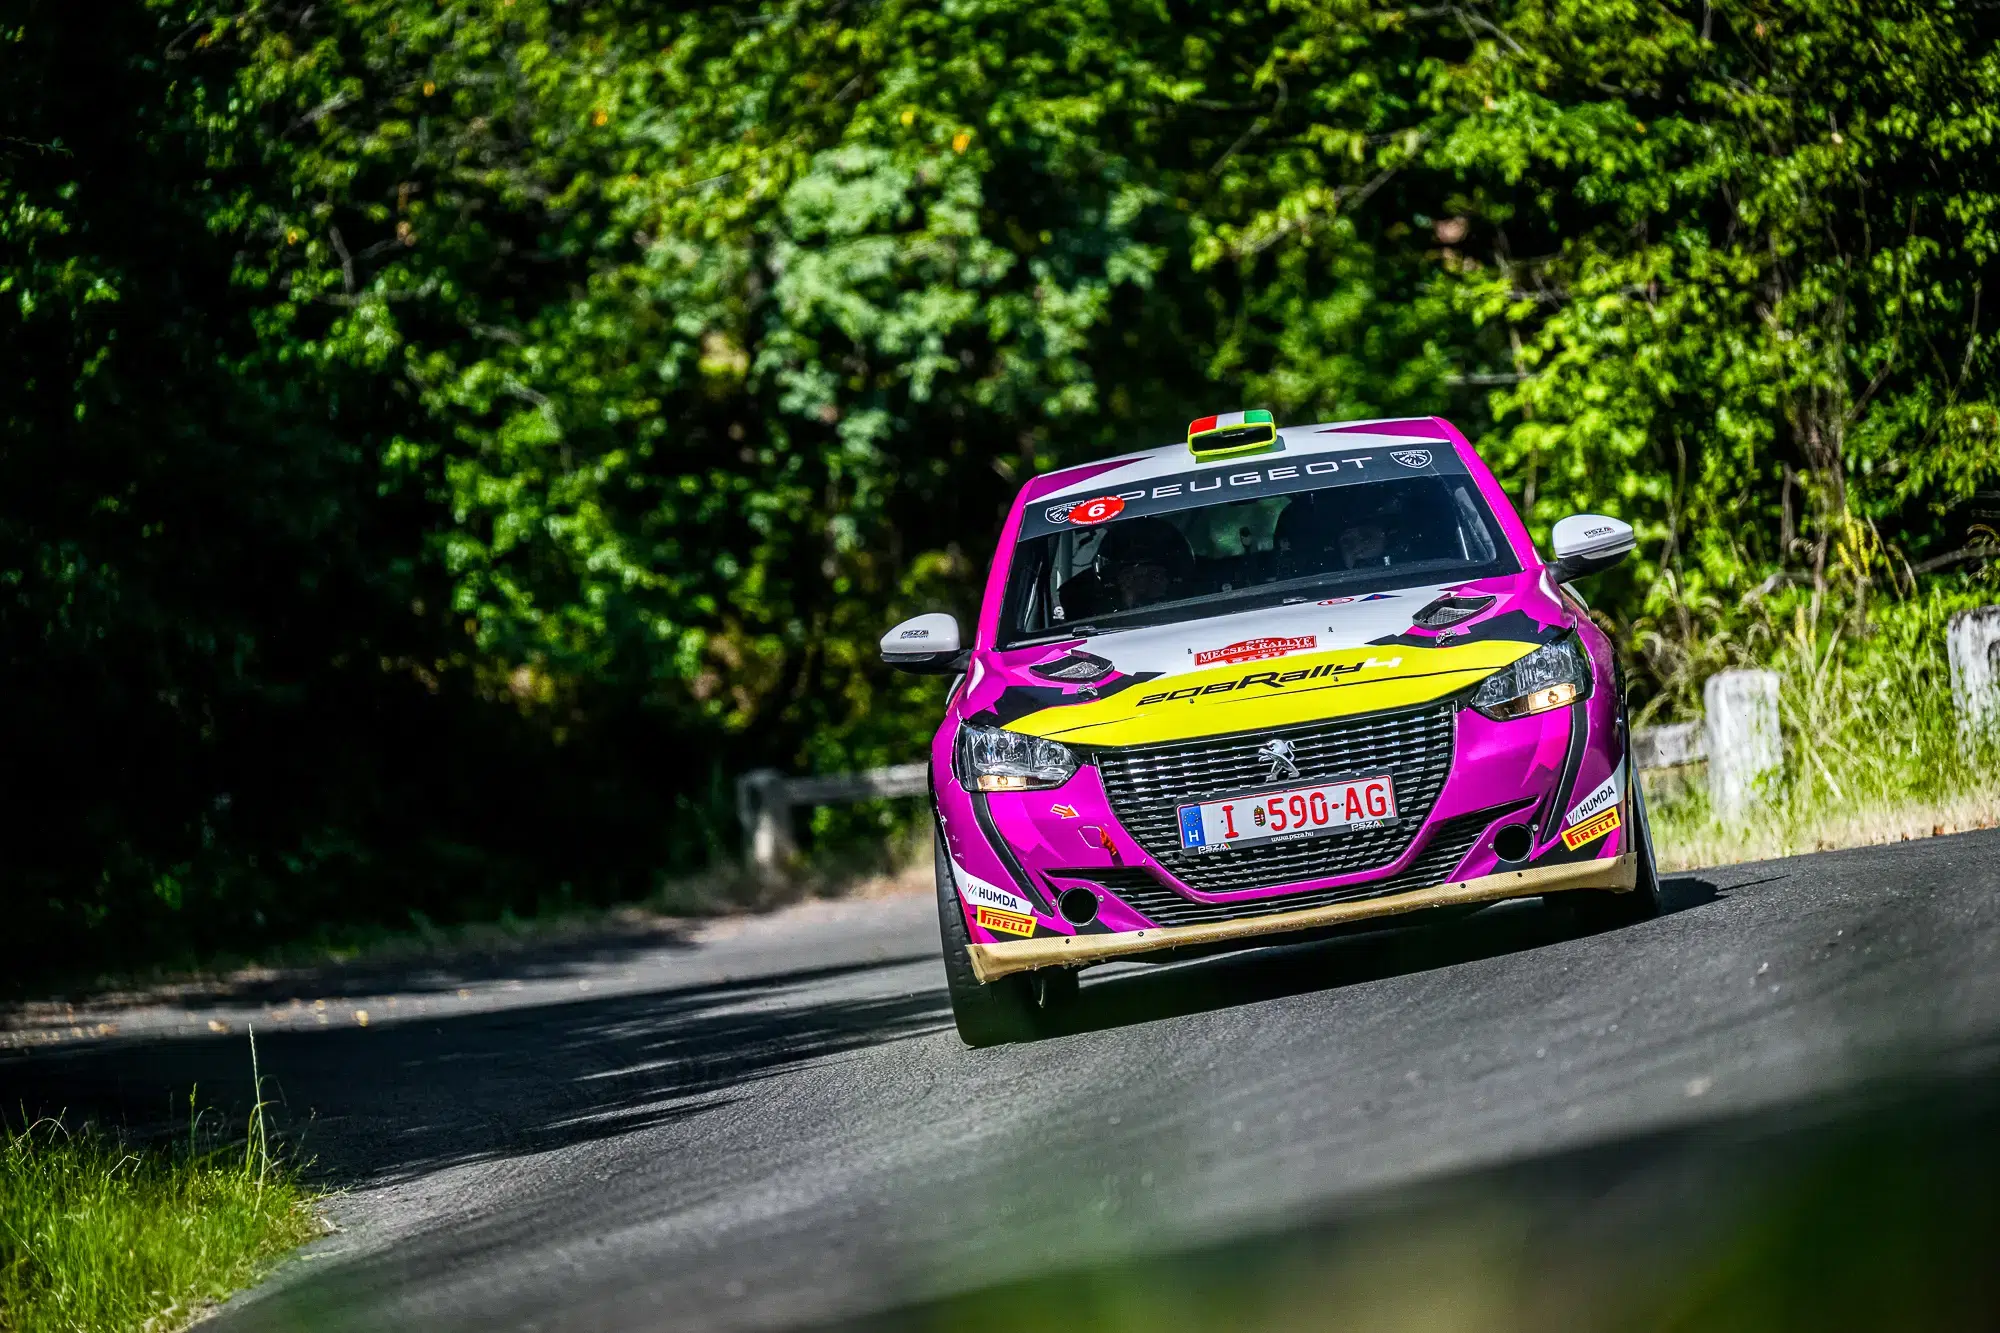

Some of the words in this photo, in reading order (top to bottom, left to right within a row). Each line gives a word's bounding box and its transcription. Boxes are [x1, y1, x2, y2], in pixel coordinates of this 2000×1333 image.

[1116, 456, 1373, 501] PEUGEOT
[1088, 503, 1106, 517] 6
[1200, 643, 1256, 663] MECSEK
[1259, 636, 1313, 650] RALLYE
[1267, 783, 1387, 832] 590-AG
[1580, 785, 1615, 816] HUMDA
[1188, 829, 1200, 843] H
[1351, 819, 1384, 832] PSZA
[1566, 811, 1616, 846] PIRELLI
[1198, 843, 1232, 854] PSZA
[978, 887, 1018, 910] HUMDA
[980, 909, 1033, 934] PIRELLI
